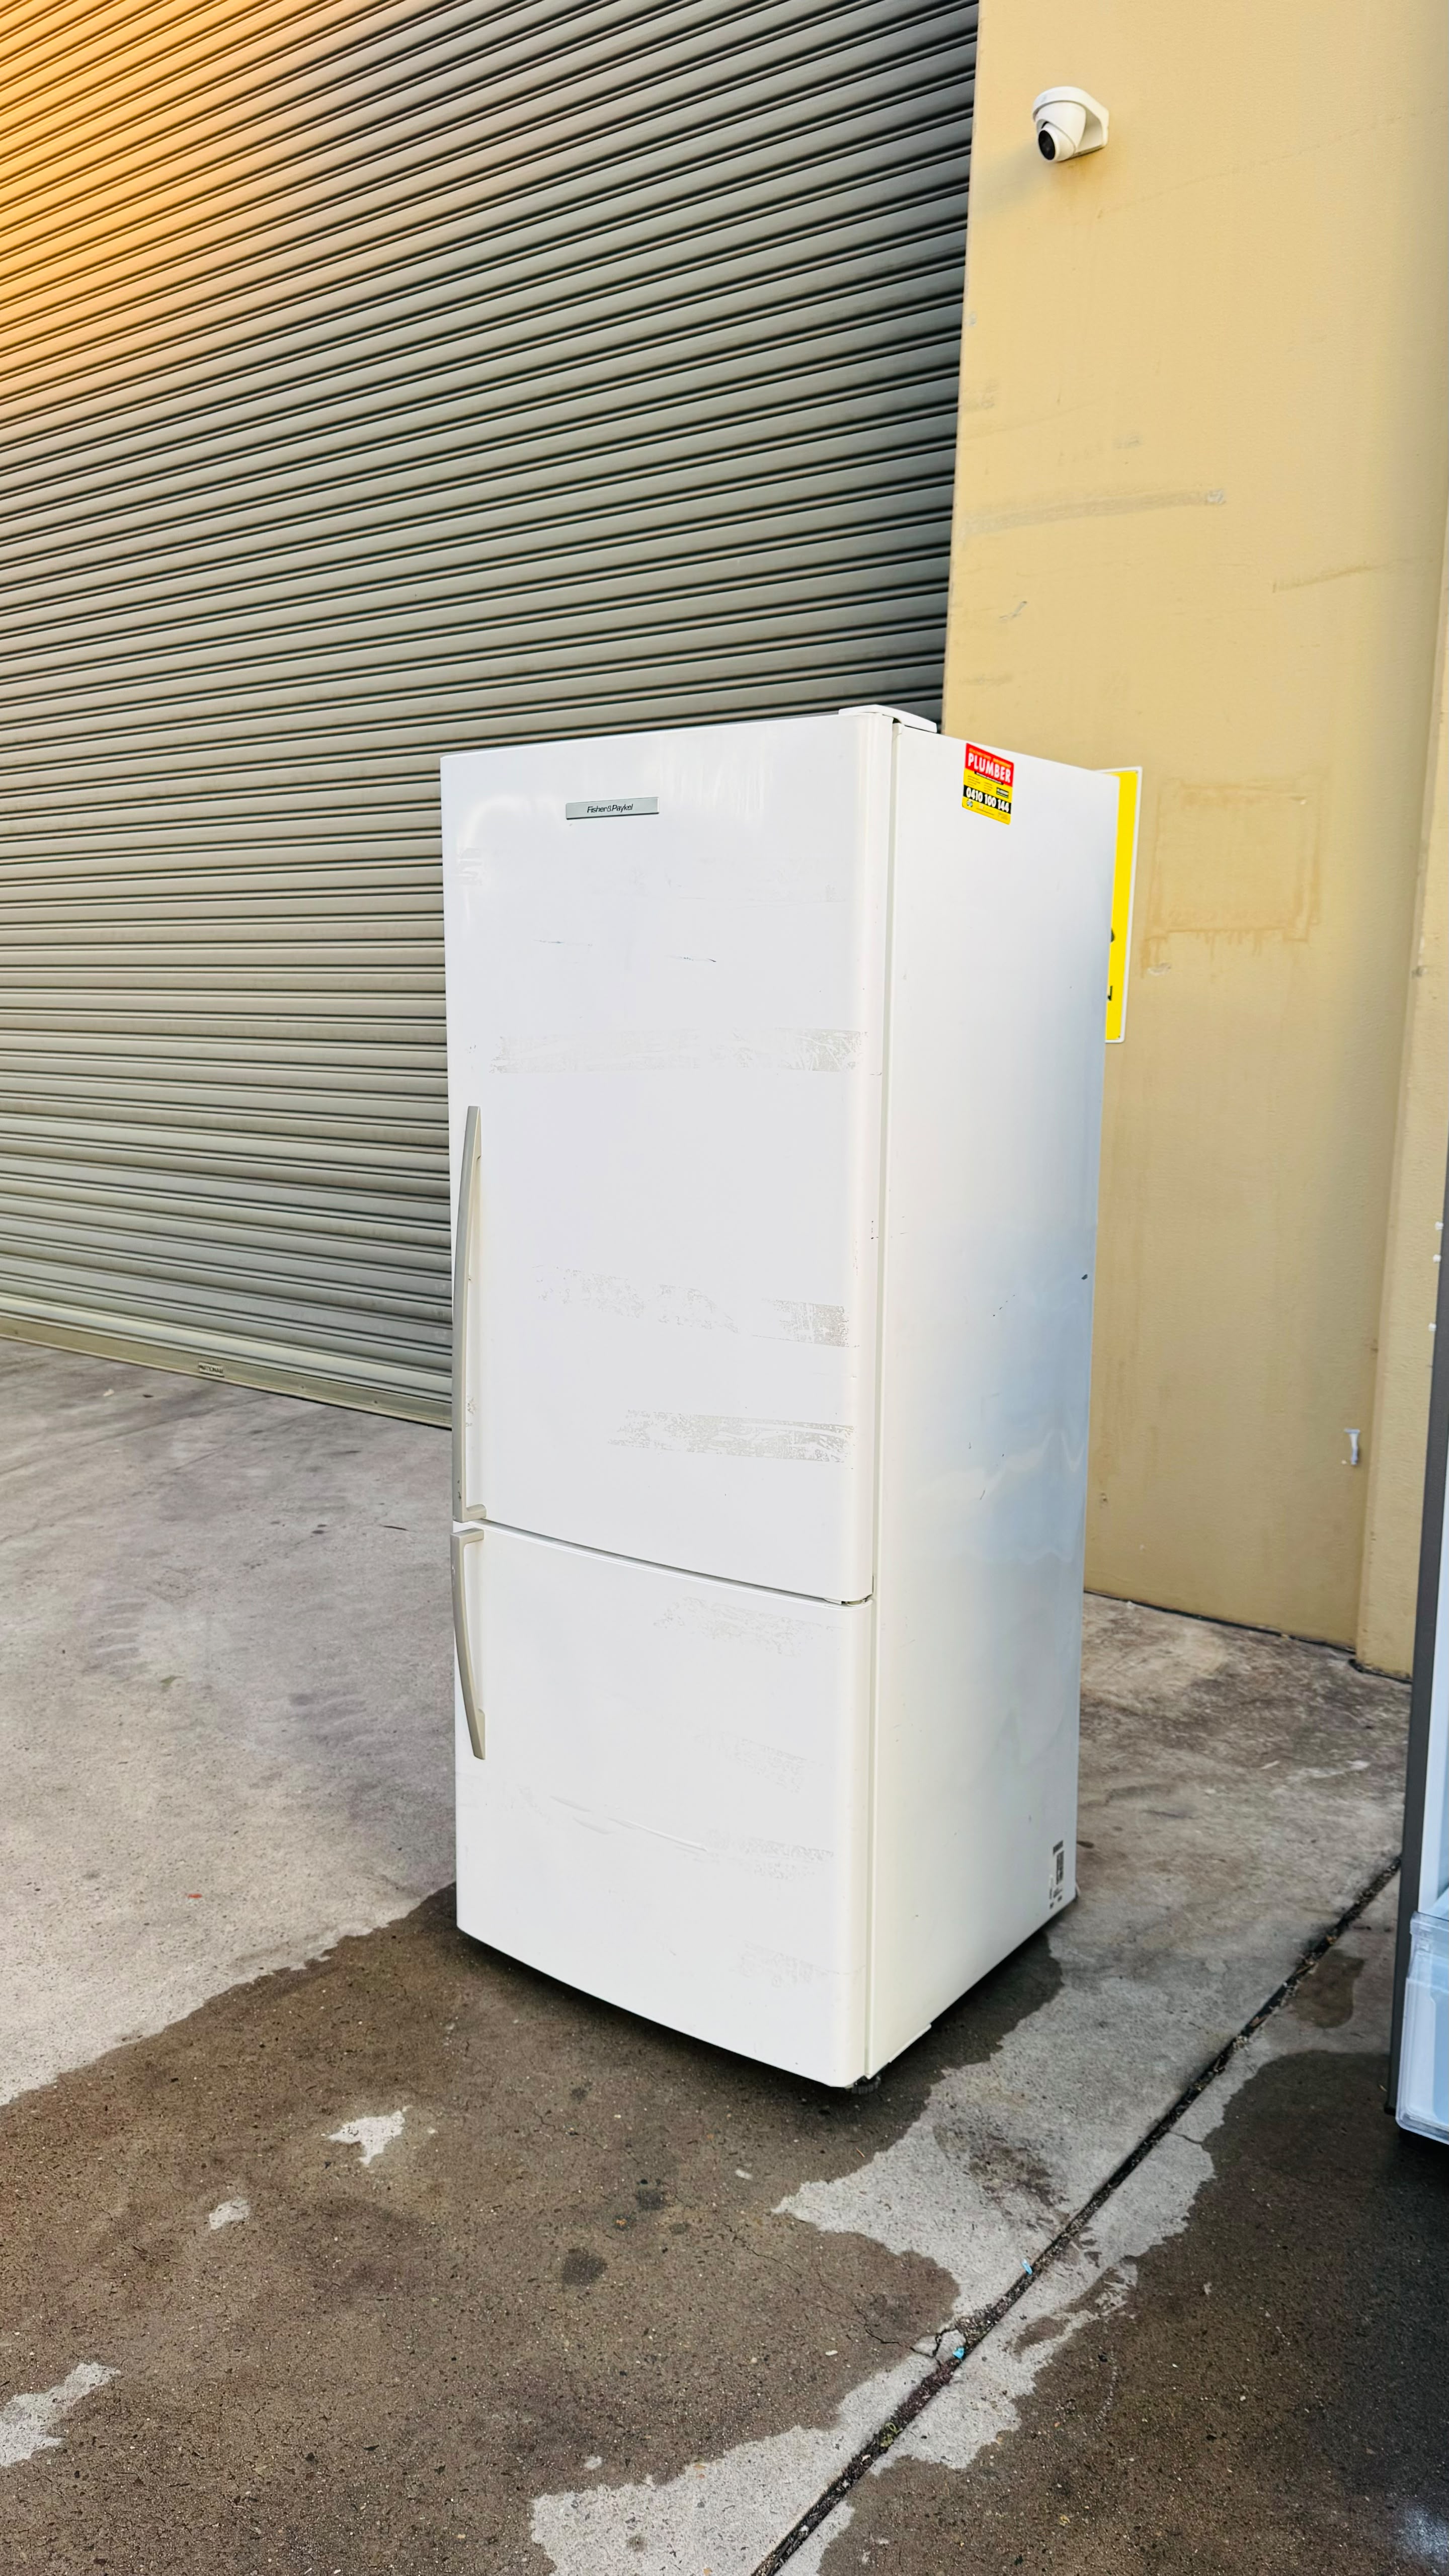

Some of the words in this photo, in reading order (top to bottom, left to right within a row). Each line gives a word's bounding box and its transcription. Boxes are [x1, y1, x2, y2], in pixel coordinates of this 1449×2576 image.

[968, 752, 1011, 783] PLUMBER
[966, 787, 983, 802] 0410
[985, 794, 996, 808] 100
[998, 799, 1009, 813] 144
